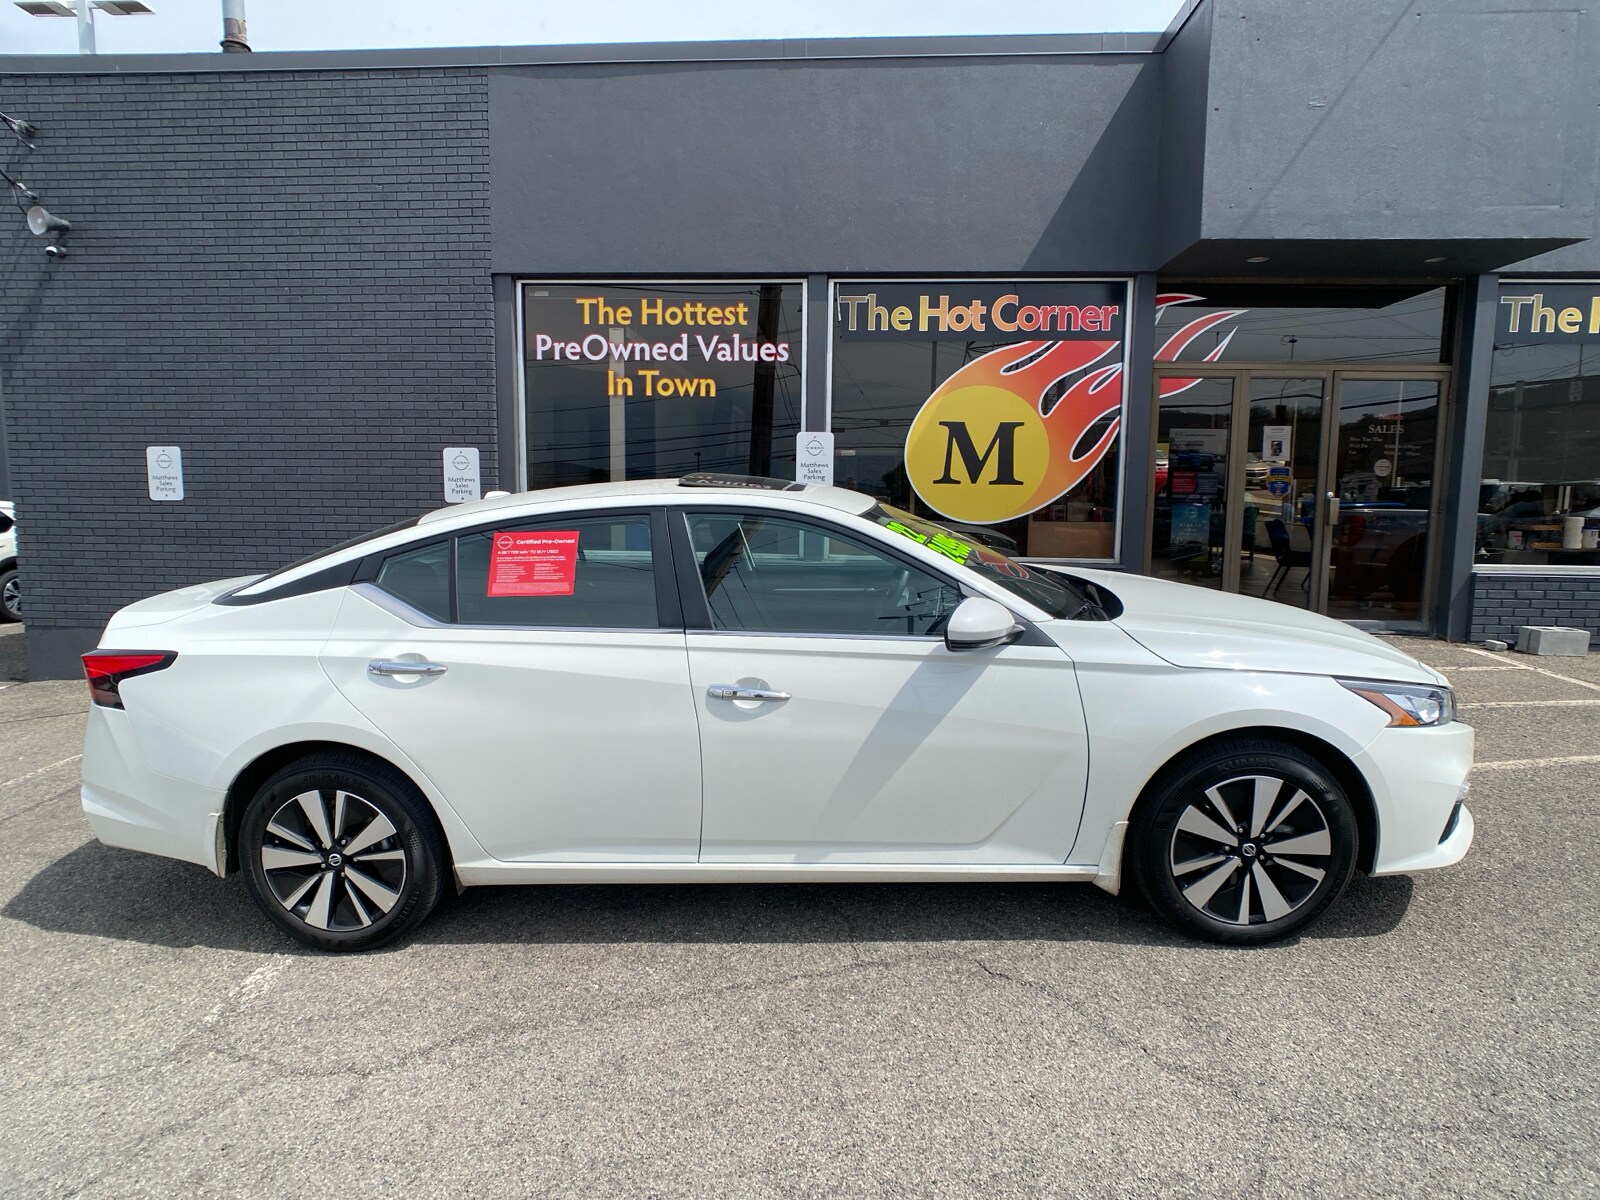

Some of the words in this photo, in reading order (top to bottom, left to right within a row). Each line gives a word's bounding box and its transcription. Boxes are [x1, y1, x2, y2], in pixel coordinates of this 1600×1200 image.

[576, 296, 632, 326] The
[640, 298, 749, 326] Hottest
[840, 294, 913, 331] The
[919, 294, 987, 332] Hot
[991, 294, 1119, 332] Corner
[1501, 294, 1583, 334] The
[536, 333, 688, 362] PreOwned
[696, 334, 790, 362] Values
[606, 370, 634, 398] In
[638, 370, 716, 398] Town
[1368, 424, 1405, 434] SALES
[932, 421, 1025, 486] M
